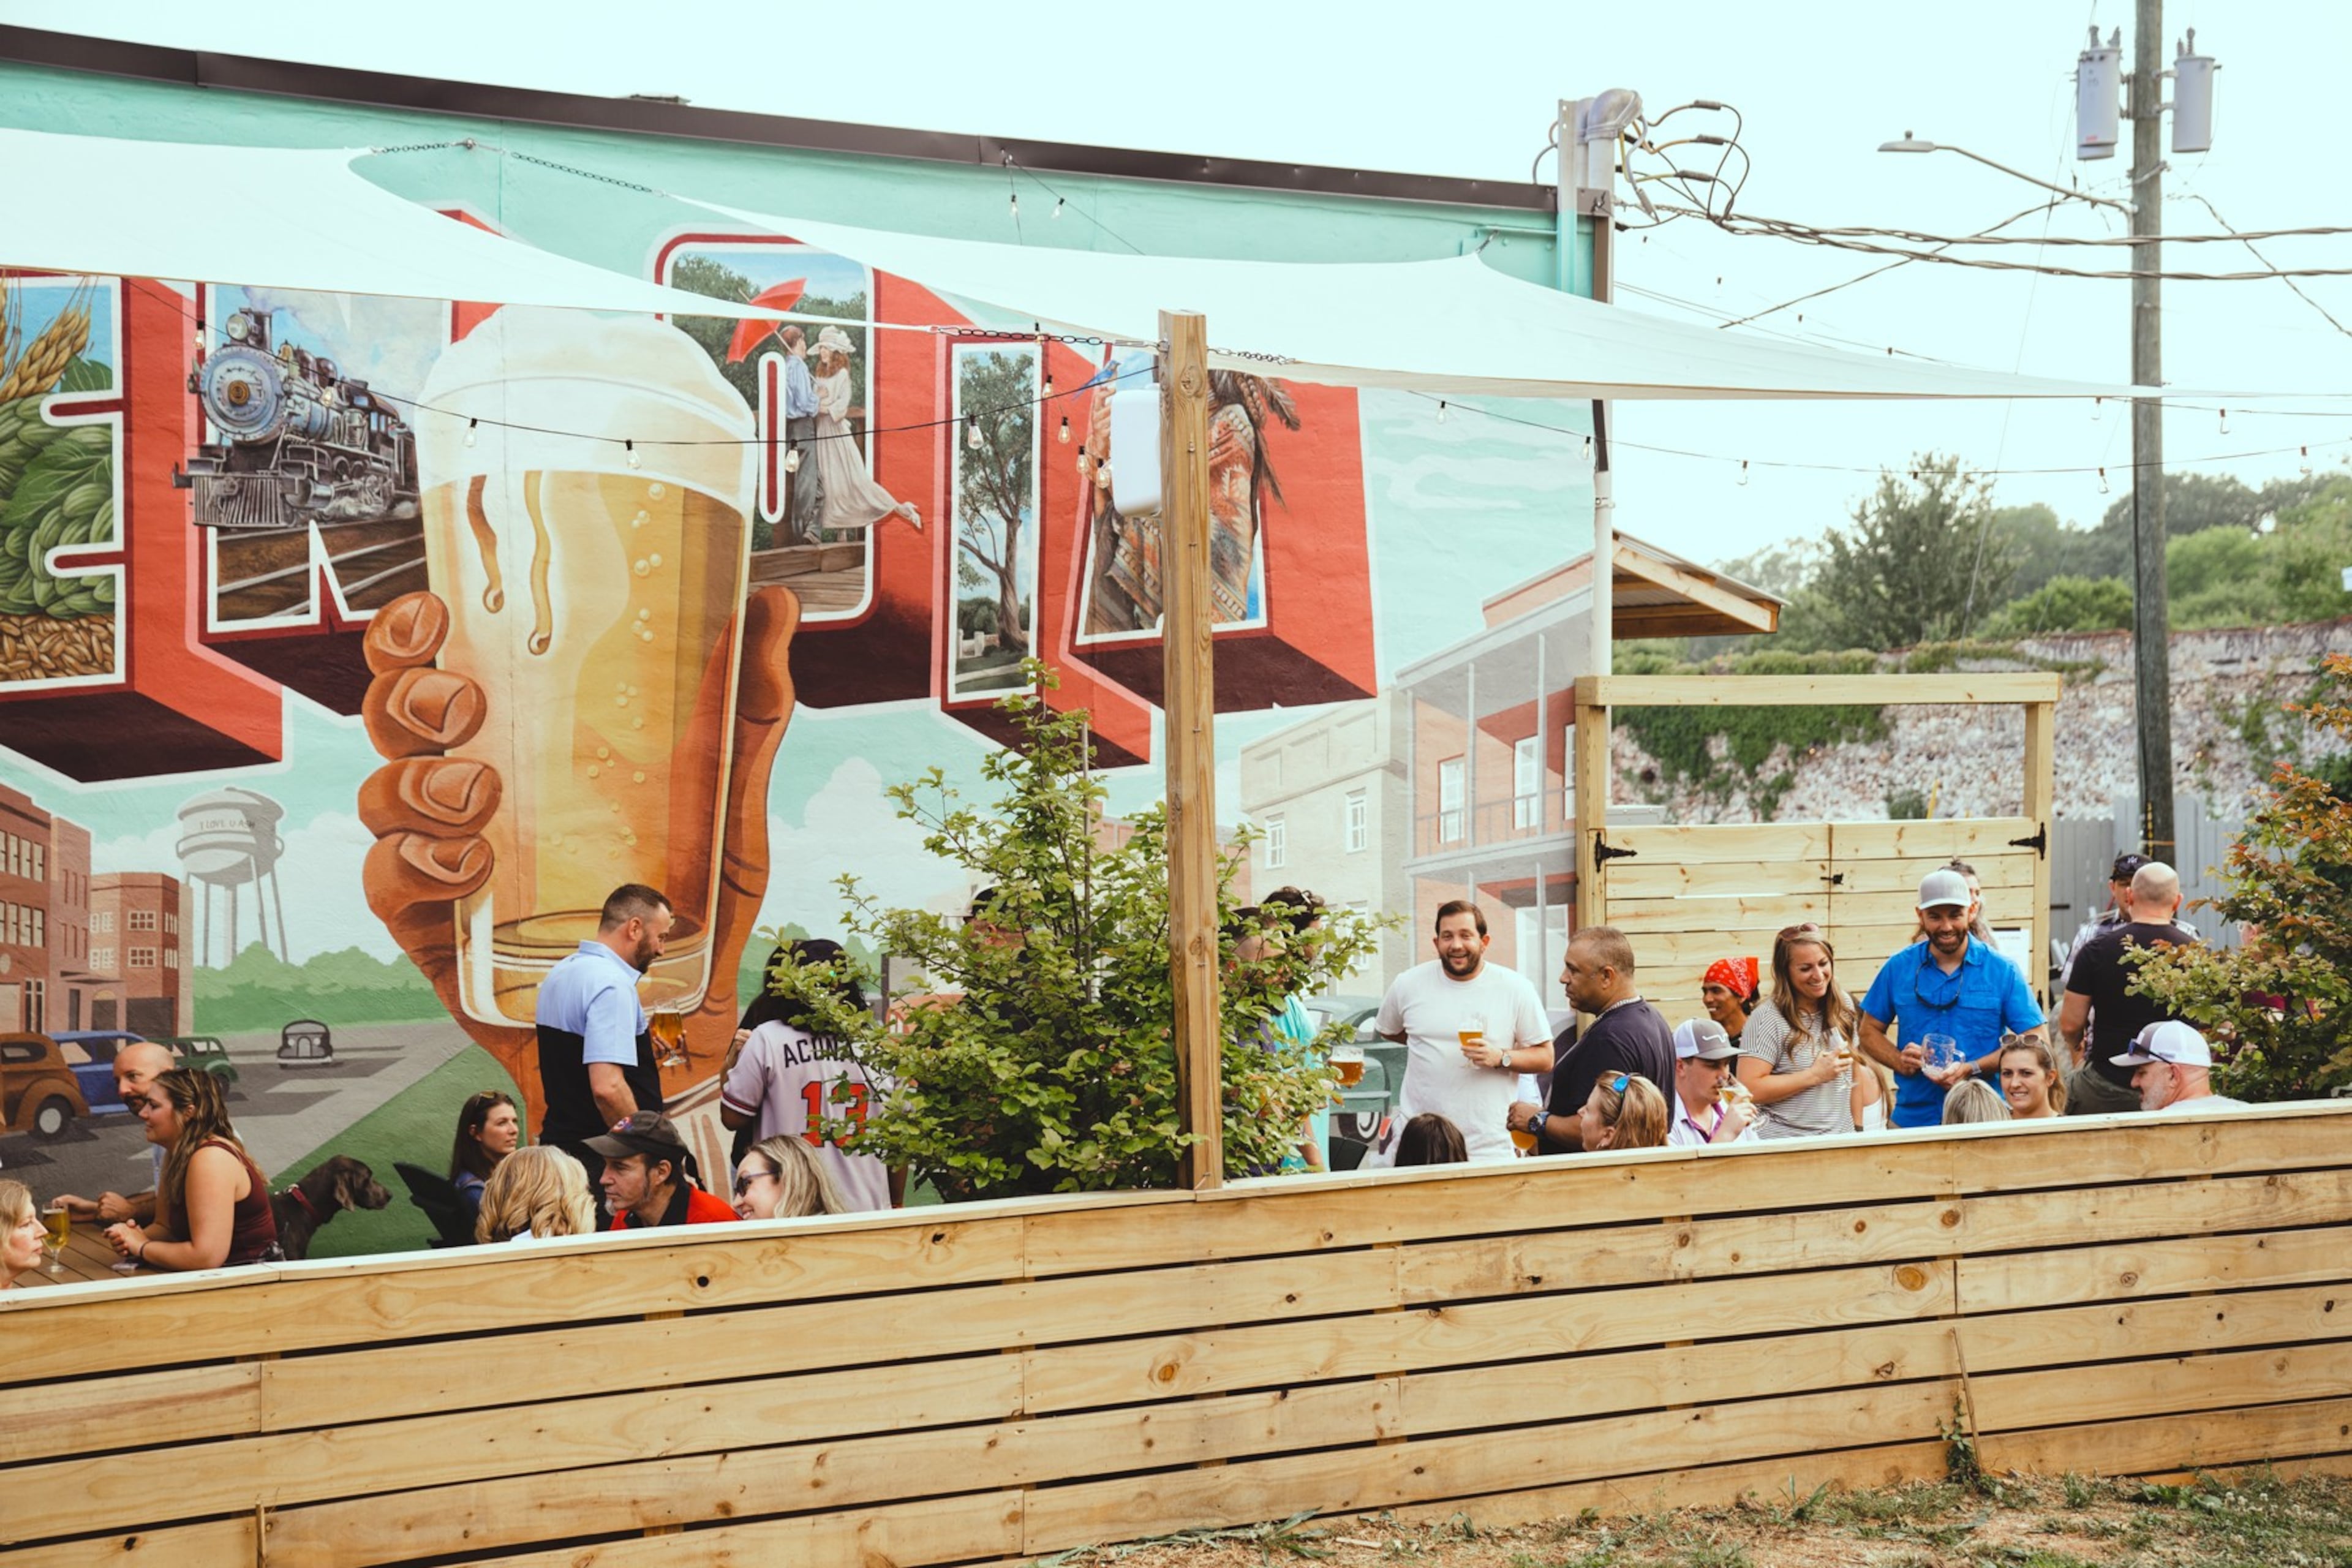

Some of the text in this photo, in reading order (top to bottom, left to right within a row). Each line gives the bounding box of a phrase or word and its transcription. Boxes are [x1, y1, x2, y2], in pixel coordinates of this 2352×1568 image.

[206, 820, 224, 829] LOVE
[229, 820, 236, 828] U
[801, 1080, 869, 1148] 13
